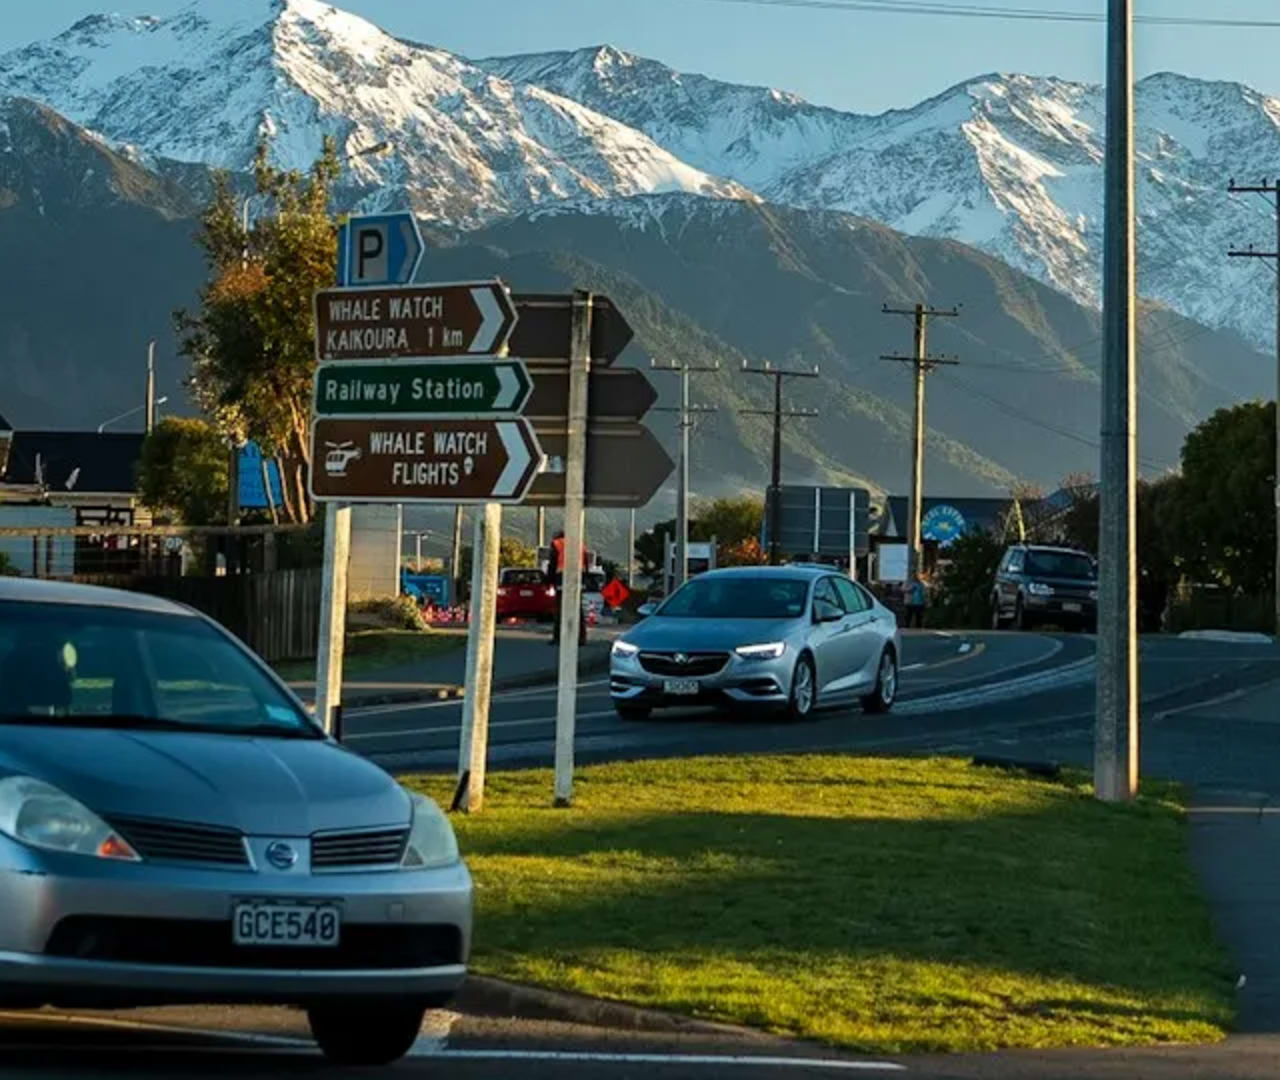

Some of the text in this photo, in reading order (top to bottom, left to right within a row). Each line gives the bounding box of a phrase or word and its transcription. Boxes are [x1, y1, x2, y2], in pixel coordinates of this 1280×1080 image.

[358, 229, 383, 279] P
[329, 296, 443, 321] WHALE WATCH
[326, 326, 463, 351] KAIKOURA 1 km
[325, 377, 484, 405] Railway Station
[370, 431, 488, 455] WHALE WATCH
[392, 461, 460, 485] FLIGHTS
[239, 910, 336, 940] GCE540
